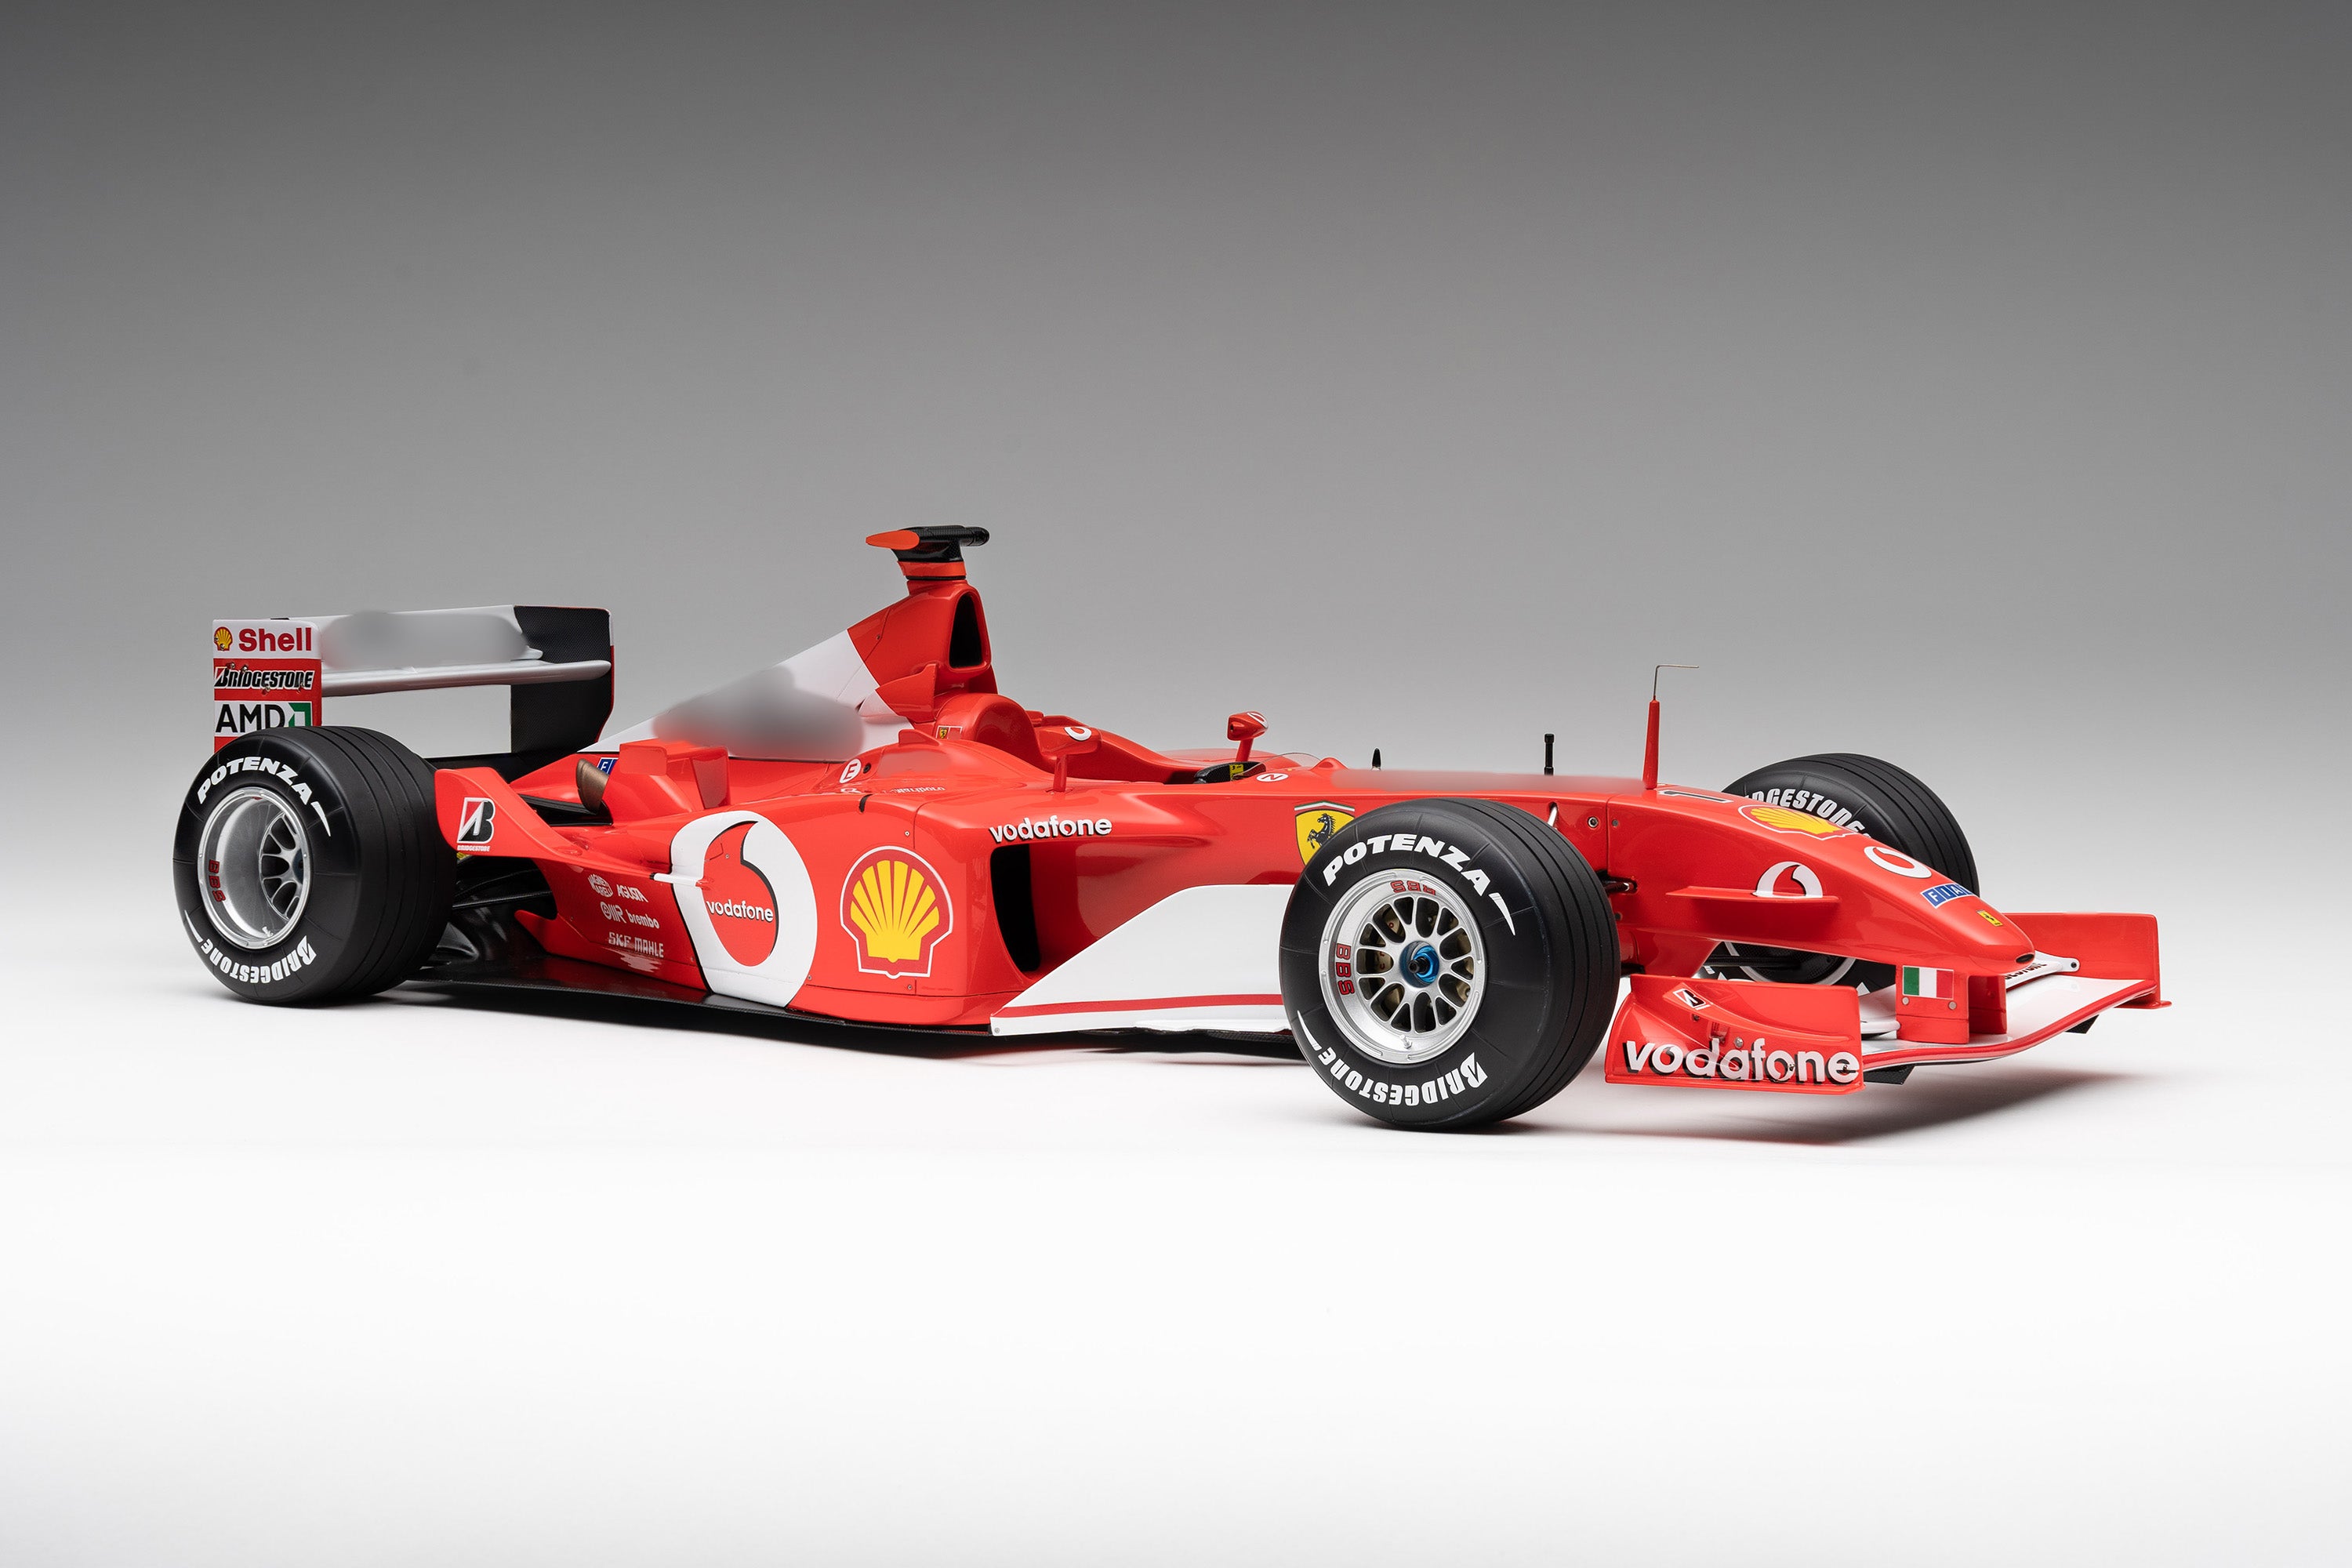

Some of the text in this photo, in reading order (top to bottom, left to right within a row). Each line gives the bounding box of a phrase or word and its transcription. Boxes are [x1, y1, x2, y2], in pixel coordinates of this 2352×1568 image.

[238, 627, 312, 652] Shell
[216, 704, 285, 733] AMD
[198, 757, 312, 804] POTENZA
[989, 815, 1112, 844] vodafone
[209, 859, 227, 902] BBS
[1323, 833, 1490, 896] POTENZA
[706, 898, 774, 923] vodafone
[1928, 885, 1966, 902] FIA
[626, 909, 660, 929] brembo
[201, 935, 317, 983] BRIDGESTONE
[608, 931, 665, 958] SKF MAHLE
[1335, 942, 1356, 996] BBS
[1318, 1047, 1488, 1106] BRIDGESTONE
[1624, 1037, 1860, 1084] vodafone
